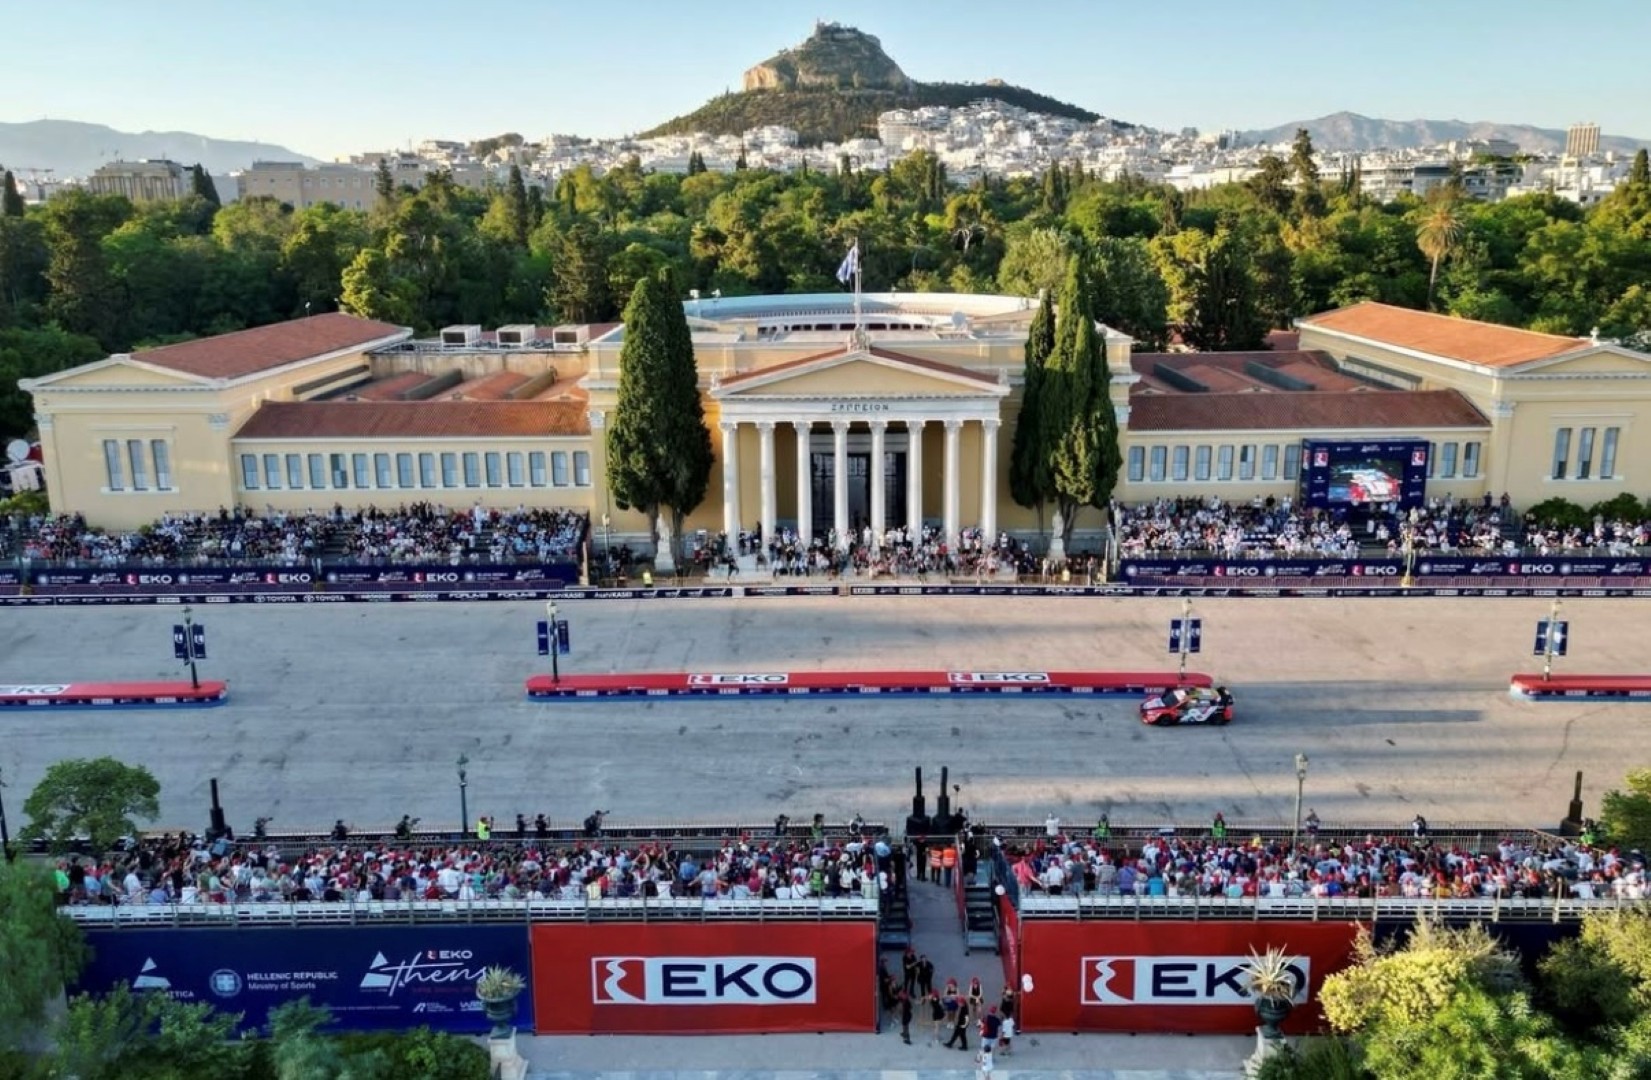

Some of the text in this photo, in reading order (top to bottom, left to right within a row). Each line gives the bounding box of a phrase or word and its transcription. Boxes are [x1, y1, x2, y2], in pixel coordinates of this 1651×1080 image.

[1226, 566, 1259, 576] EKO
[1364, 565, 1397, 576] EKO
[1521, 564, 1555, 574] EKO
[138, 575, 172, 584] EKO
[278, 573, 311, 584] EKO
[425, 572, 458, 582] EKO
[719, 675, 786, 683] EKO
[979, 673, 1047, 681] EKO
[439, 950, 473, 959] EKO
[247, 971, 339, 981] HELLENIC REPUBLIC
[662, 962, 813, 999] EKO
[248, 981, 316, 991] Ministry of Sports
